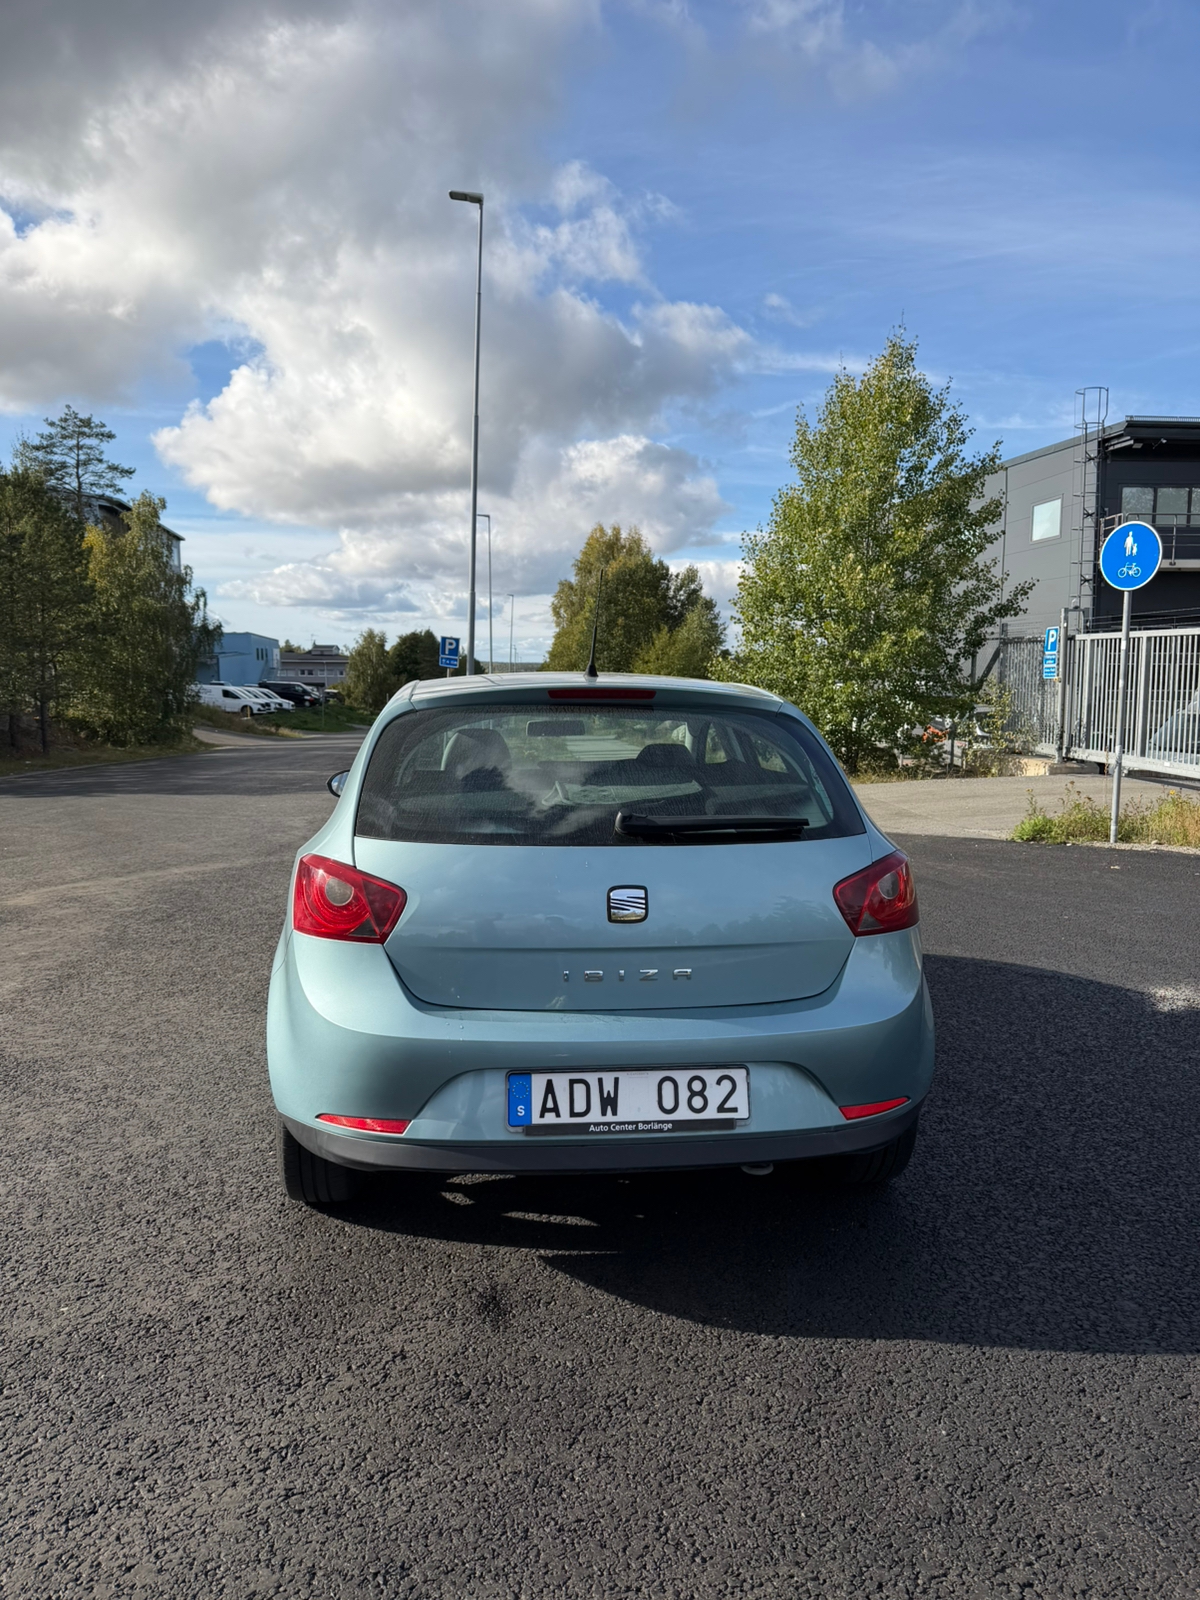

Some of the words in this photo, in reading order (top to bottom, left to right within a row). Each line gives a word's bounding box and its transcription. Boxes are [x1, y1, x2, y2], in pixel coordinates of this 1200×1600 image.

[445, 639, 456, 655] P
[1048, 630, 1057, 650] P
[563, 968, 692, 982] IBIZA
[539, 1076, 620, 1119] ADW
[657, 1074, 739, 1115] 082
[516, 1105, 526, 1117] S
[589, 1124, 609, 1132] Auto
[610, 1123, 636, 1131] Center
[638, 1121, 673, 1131] Borlänge
